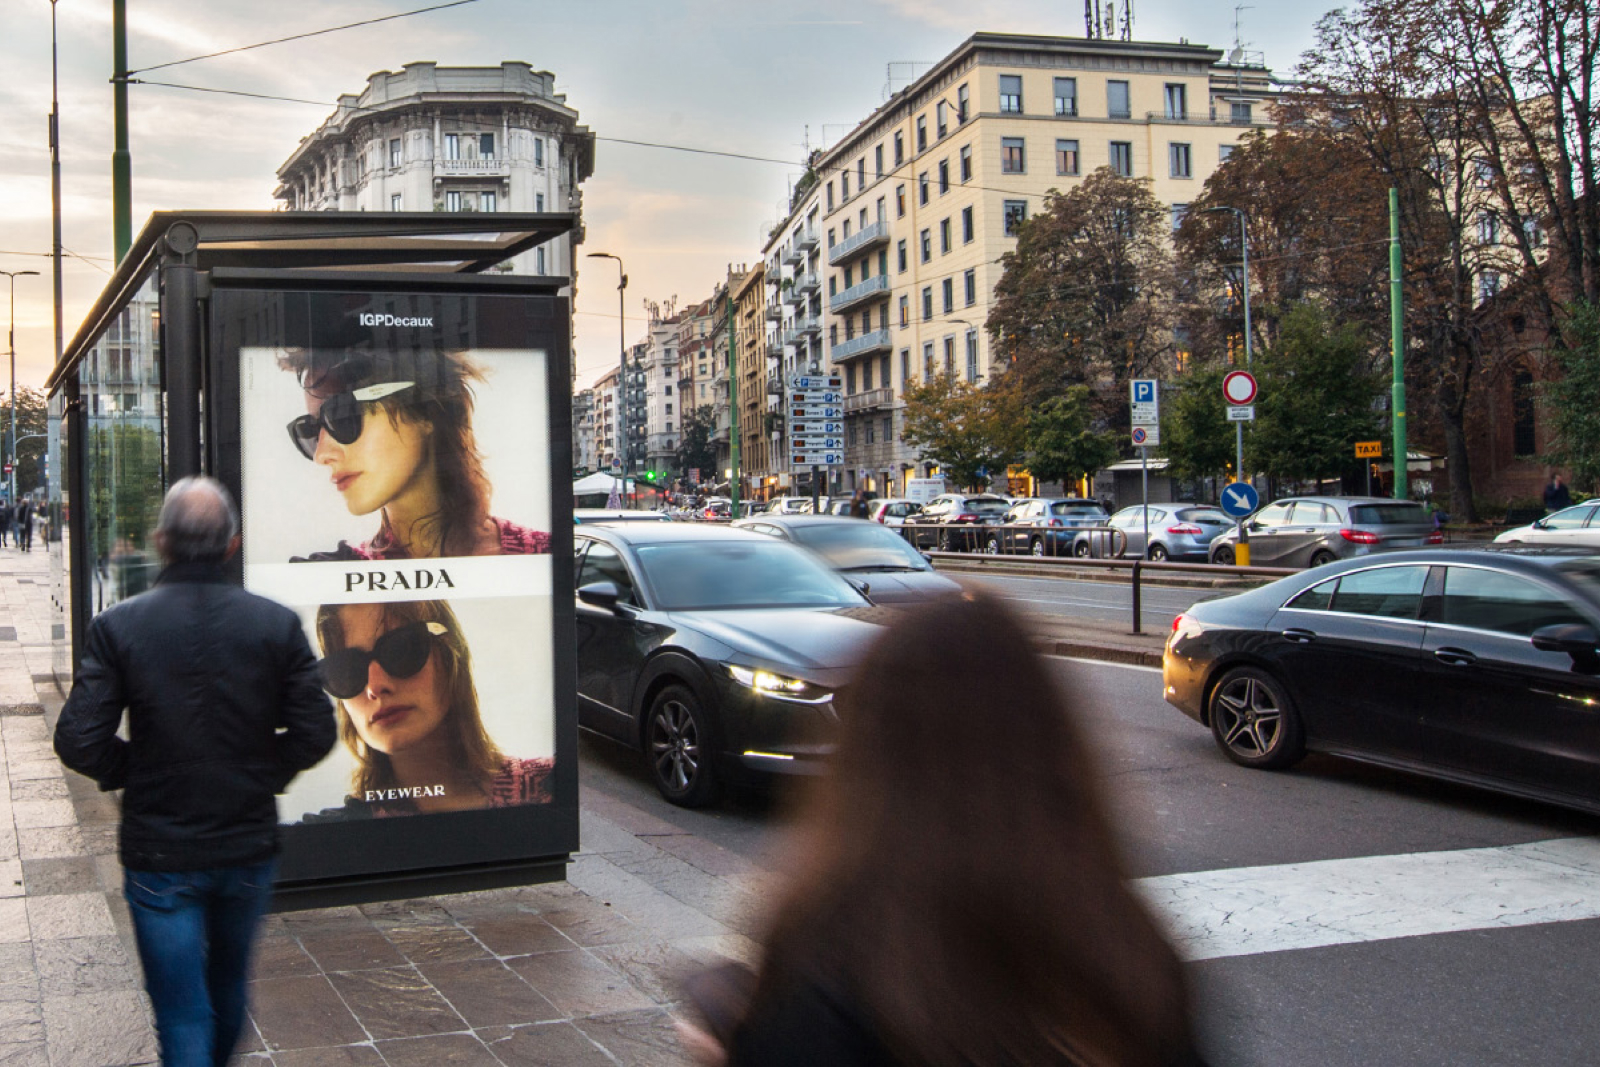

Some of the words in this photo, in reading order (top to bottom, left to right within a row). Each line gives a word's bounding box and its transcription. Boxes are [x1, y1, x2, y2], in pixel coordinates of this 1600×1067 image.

[360, 313, 434, 327] IGPDecaux
[1138, 383, 1149, 400] P
[1356, 444, 1381, 454] TAXI
[345, 568, 456, 592] PRADA
[364, 784, 446, 802] EYEWEAR
